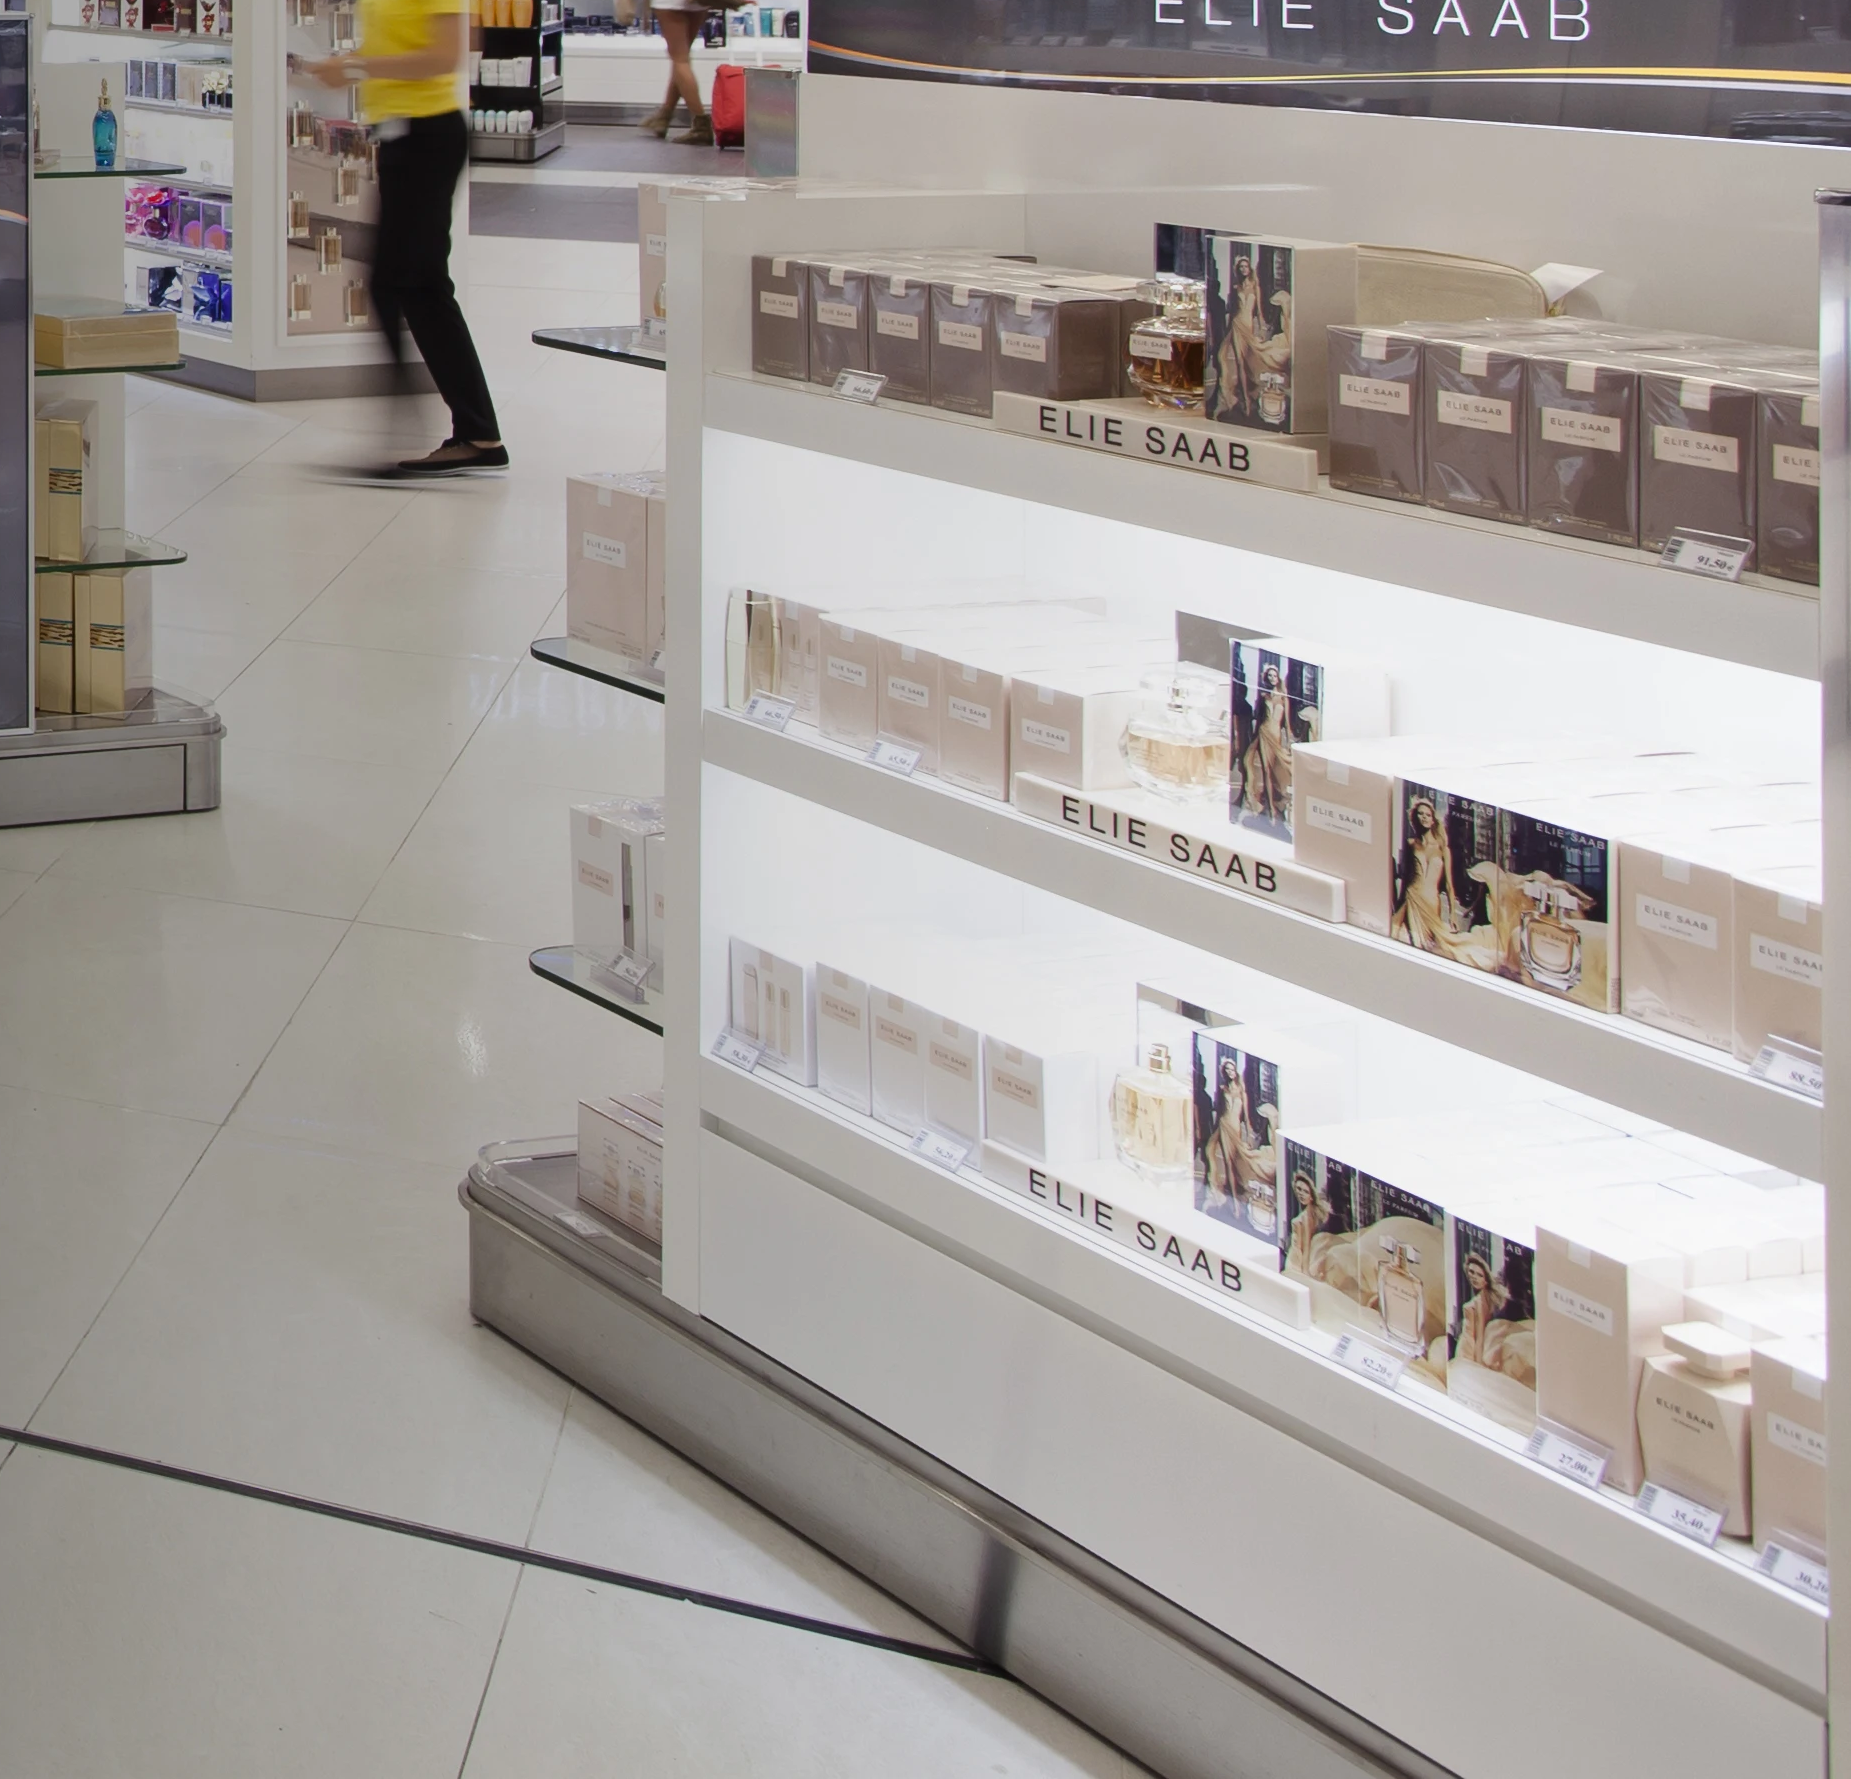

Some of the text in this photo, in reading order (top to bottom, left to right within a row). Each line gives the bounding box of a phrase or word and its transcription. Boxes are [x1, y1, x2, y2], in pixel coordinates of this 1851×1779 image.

[1347, 383, 1401, 399] ELIE SAAB
[1445, 399, 1503, 416] ELIE SAAB
[1549, 416, 1611, 434] ELIE SAAB
[1040, 406, 1250, 471] ELIE SAAB
[1663, 435, 1728, 455] ELIE SAAB
[1782, 454, 1811, 468] ELIE
[1312, 805, 1365, 828] ELIE SAAB
[1461, 799, 1494, 816] SAAB
[1063, 795, 1277, 893] ELIE SAAB
[1535, 822, 1606, 850] ELIE SAAB
[1644, 903, 1709, 931] ELIE SAAB
[1758, 944, 1787, 962] ELIE
[1287, 1142, 1310, 1160] ELIE
[1370, 1179, 1430, 1214] ELIE SAAB
[1029, 1168, 1243, 1293] ELIE SAAB
[1458, 1221, 1485, 1240] ELIE
[1553, 1291, 1606, 1321] ELIE SAAB
[1656, 1398, 1715, 1430] ELIE SAAB
[1775, 1423, 1803, 1440] ELIE
